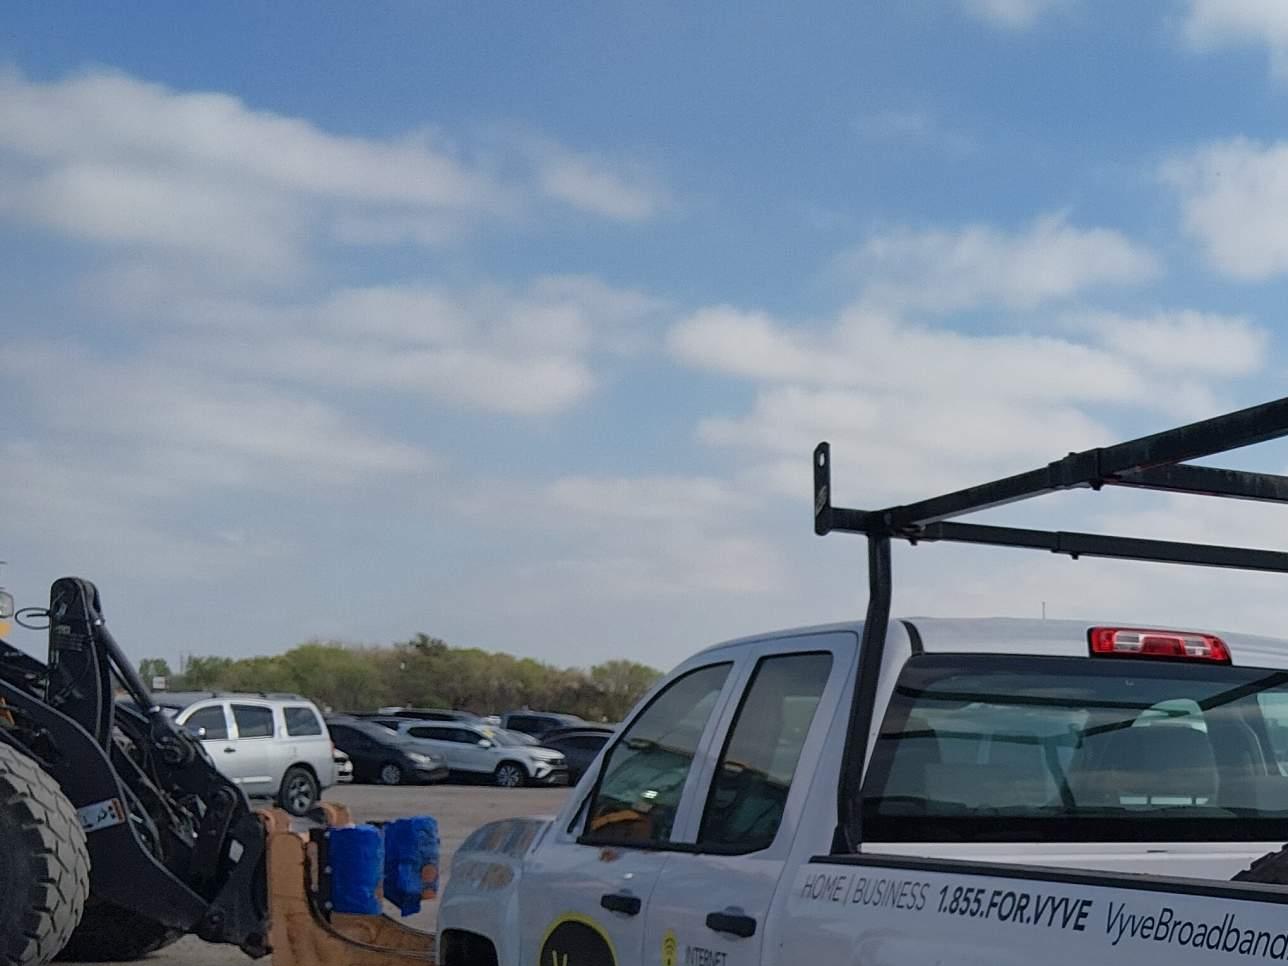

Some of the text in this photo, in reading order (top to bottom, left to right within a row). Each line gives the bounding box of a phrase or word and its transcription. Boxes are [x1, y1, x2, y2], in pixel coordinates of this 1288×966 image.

[801, 874, 846, 902] HOME
[852, 876, 931, 911] BUSINESS
[937, 885, 1093, 932] 1.855.FOR.VYVE
